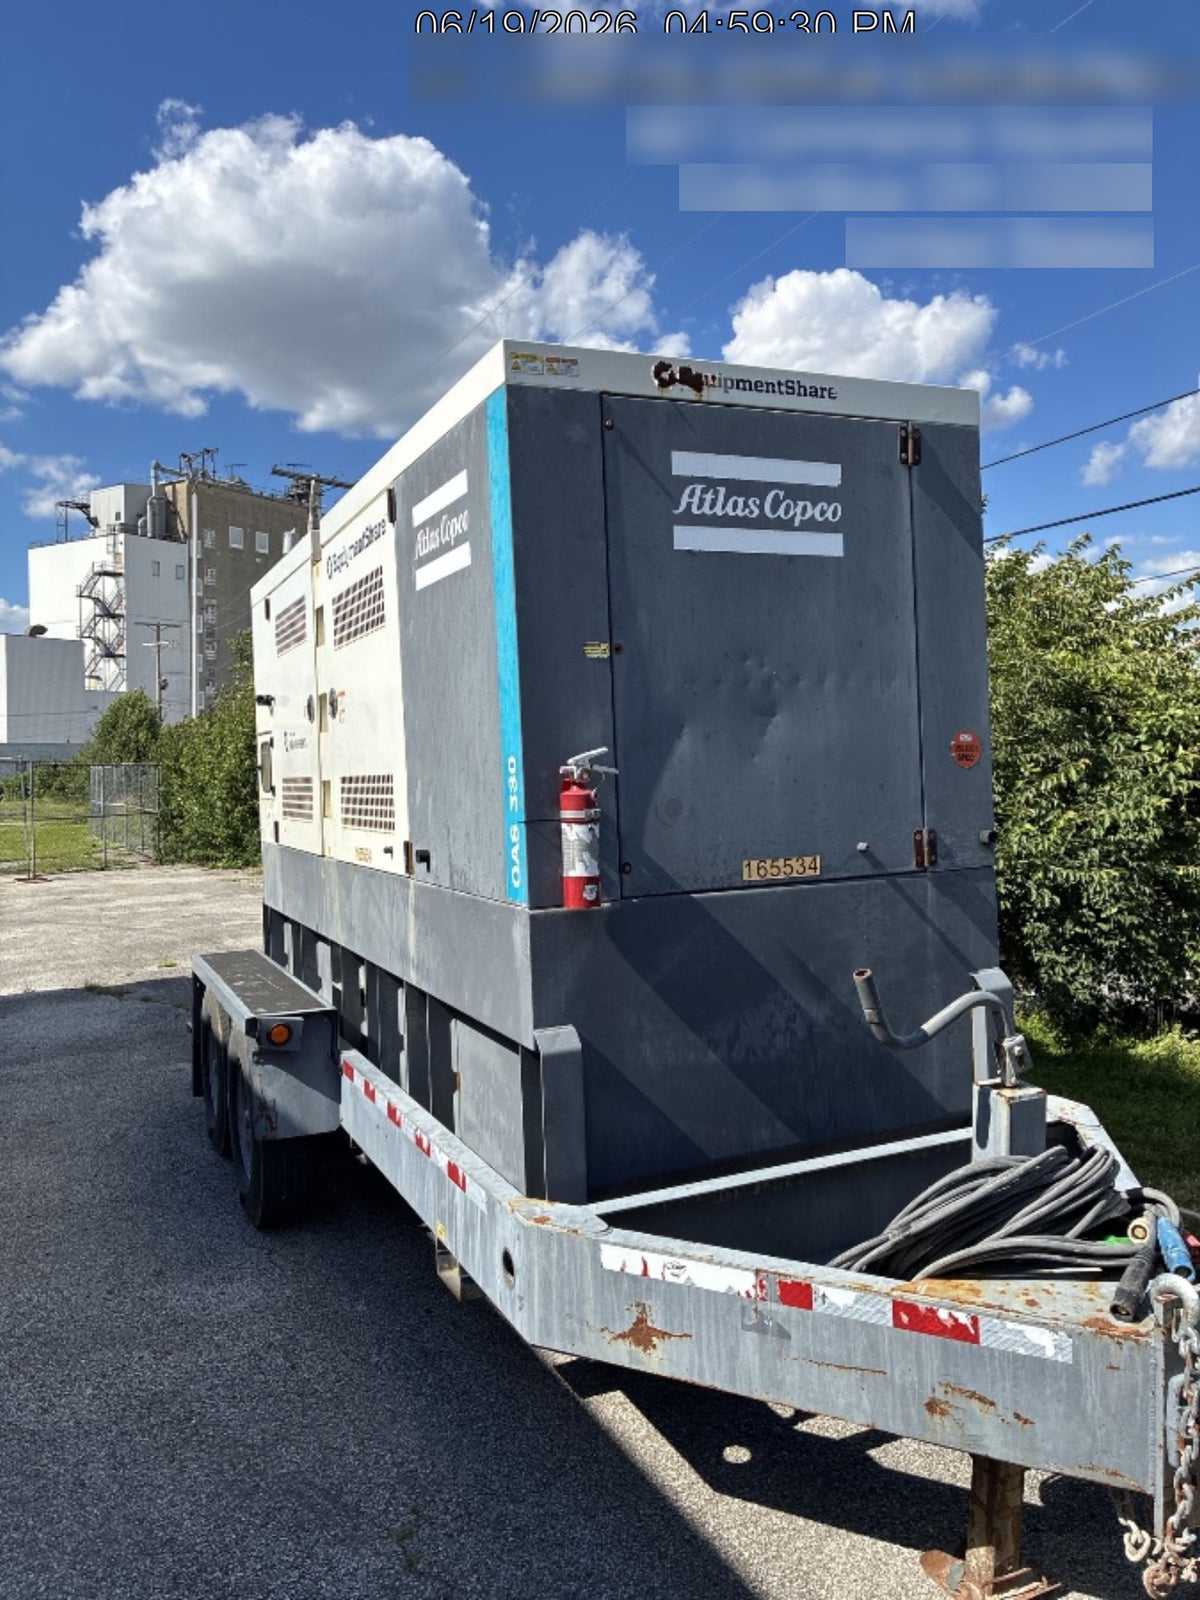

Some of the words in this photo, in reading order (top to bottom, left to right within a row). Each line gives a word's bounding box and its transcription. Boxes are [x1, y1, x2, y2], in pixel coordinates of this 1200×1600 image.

[672, 484, 760, 518] Atlas
[764, 489, 842, 527] Copco
[414, 526, 439, 561] Atlas
[440, 510, 470, 546] Copco
[744, 856, 819, 879] 165534
